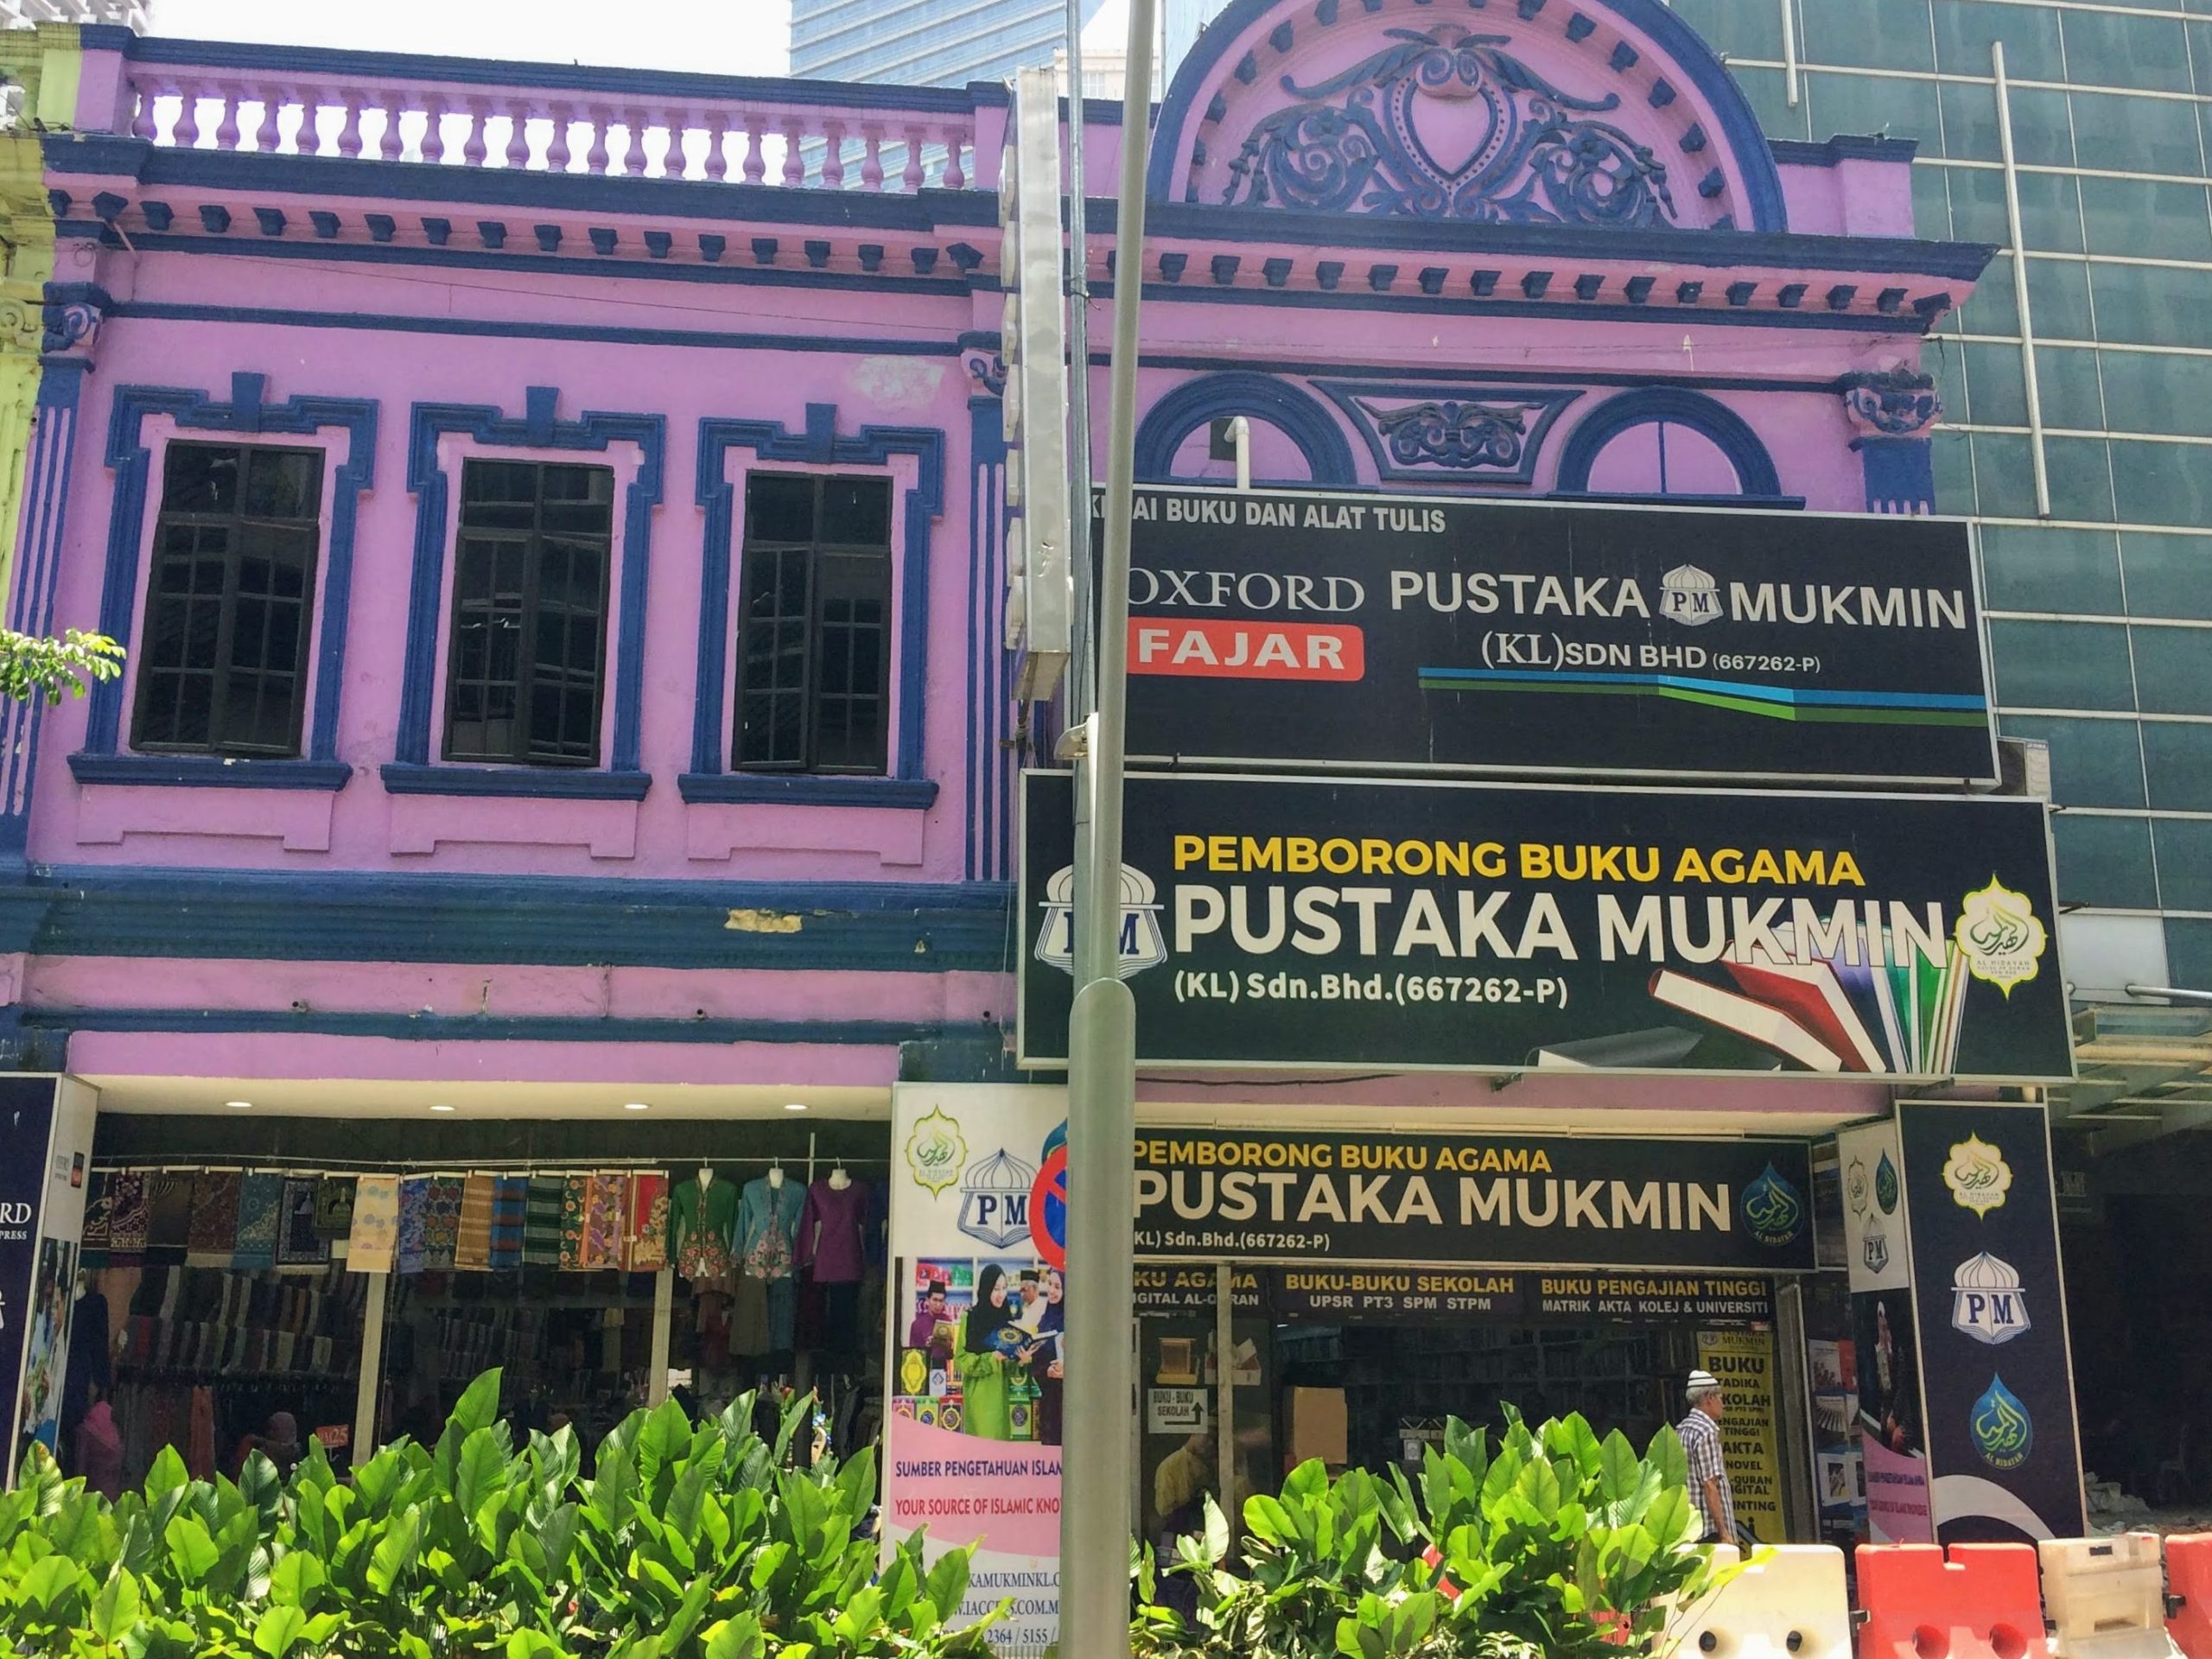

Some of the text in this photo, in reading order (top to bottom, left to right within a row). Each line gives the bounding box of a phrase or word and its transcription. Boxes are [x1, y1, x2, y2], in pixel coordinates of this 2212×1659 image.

[1091, 494, 1446, 533] KAI BUKU DAN ALAT TULIS
[1129, 567, 1365, 613] OXFORD
[1390, 570, 1651, 619] PUSTAKA
[1730, 582, 1967, 630] MUKMIN
[1138, 628, 1345, 671] FAJAR
[1640, 645, 1707, 670] BHD
[1713, 652, 1821, 673] (667262-P)
[1173, 835, 1866, 887] PEMBORONG BUKU AGAMA
[1174, 884, 1949, 969] PUSTAKA MUKMIN
[1174, 970, 1240, 1004] (KL)
[1134, 1140, 1552, 1173] PEMBORONG BUKU AGAMA
[1134, 1170, 1731, 1231] PUSTAKA MUKMIN
[0, 1203, 32, 1224] RD
[977, 1195, 1027, 1225] PM
[1134, 1230, 1160, 1249] KL)
[1134, 1271, 1166, 1287] KU
[1286, 1274, 1513, 1293] BUKU-BUKU SEKOLAH
[1541, 1279, 1766, 1296] BUKU PENGAJIAN TINGGI
[1133, 1293, 1258, 1306] IGITAL AL-QRAN
[1309, 1295, 1491, 1310] UPSR PT3 SPM STPM
[1542, 1300, 1768, 1314] MATRIK AKTA KOLEJ & UNIVERSITI
[1967, 1294, 2014, 1325] PM
[1708, 1357, 1764, 1374] BUKU
[1722, 1394, 1770, 1407] KOLAH
[1716, 1417, 1769, 1427] ENGAJIAN
[1725, 1427, 1759, 1436] TINGGI
[1723, 1442, 1764, 1454] AKTA
[896, 1461, 941, 1477] SUMBER
[945, 1460, 1028, 1476] PENGETAHUAN
[1726, 1460, 1763, 1470] NOVEL
[1729, 1476, 1772, 1484] -QURAN
[1732, 1485, 1770, 1495] IGITAL
[896, 1497, 1061, 1516] YOUR SOURCE OF ISLAMIC KNO
[1733, 1501, 1776, 1511] INTING
[969, 1572, 1060, 1587] KAMUKMINKL.C
[988, 1629, 1012, 1643] 2364
[1023, 1629, 1047, 1643] 5155
